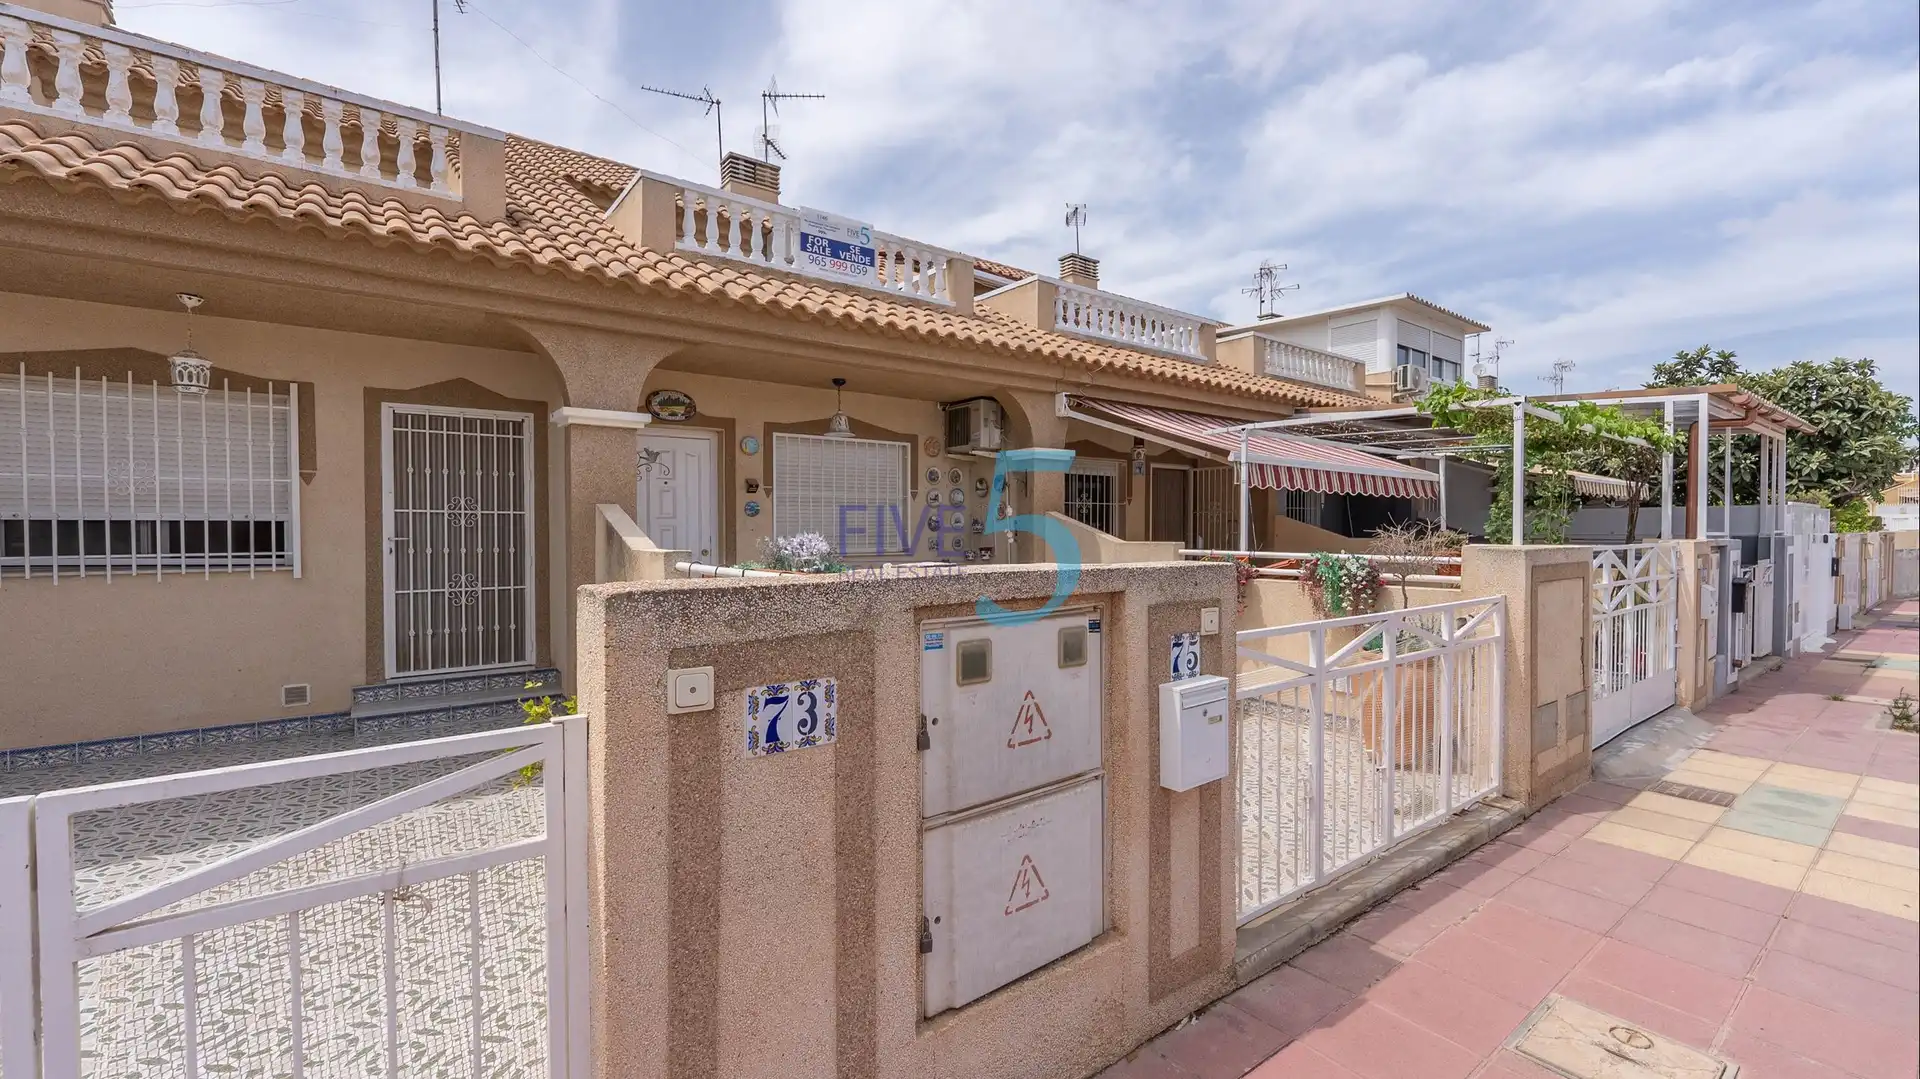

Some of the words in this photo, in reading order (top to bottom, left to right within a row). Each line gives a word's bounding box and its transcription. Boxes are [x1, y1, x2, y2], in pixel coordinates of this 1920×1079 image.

[808, 235, 829, 247] FOR
[847, 227, 860, 239] FIVE
[860, 226, 871, 246] 5
[806, 243, 832, 257] SALE
[839, 250, 871, 265] VENDE
[849, 245, 861, 255] SE
[808, 254, 827, 267] 965
[829, 259, 848, 271] 999
[849, 263, 868, 276] 059
[1171, 639, 1199, 674] 75
[762, 691, 818, 744] 73
